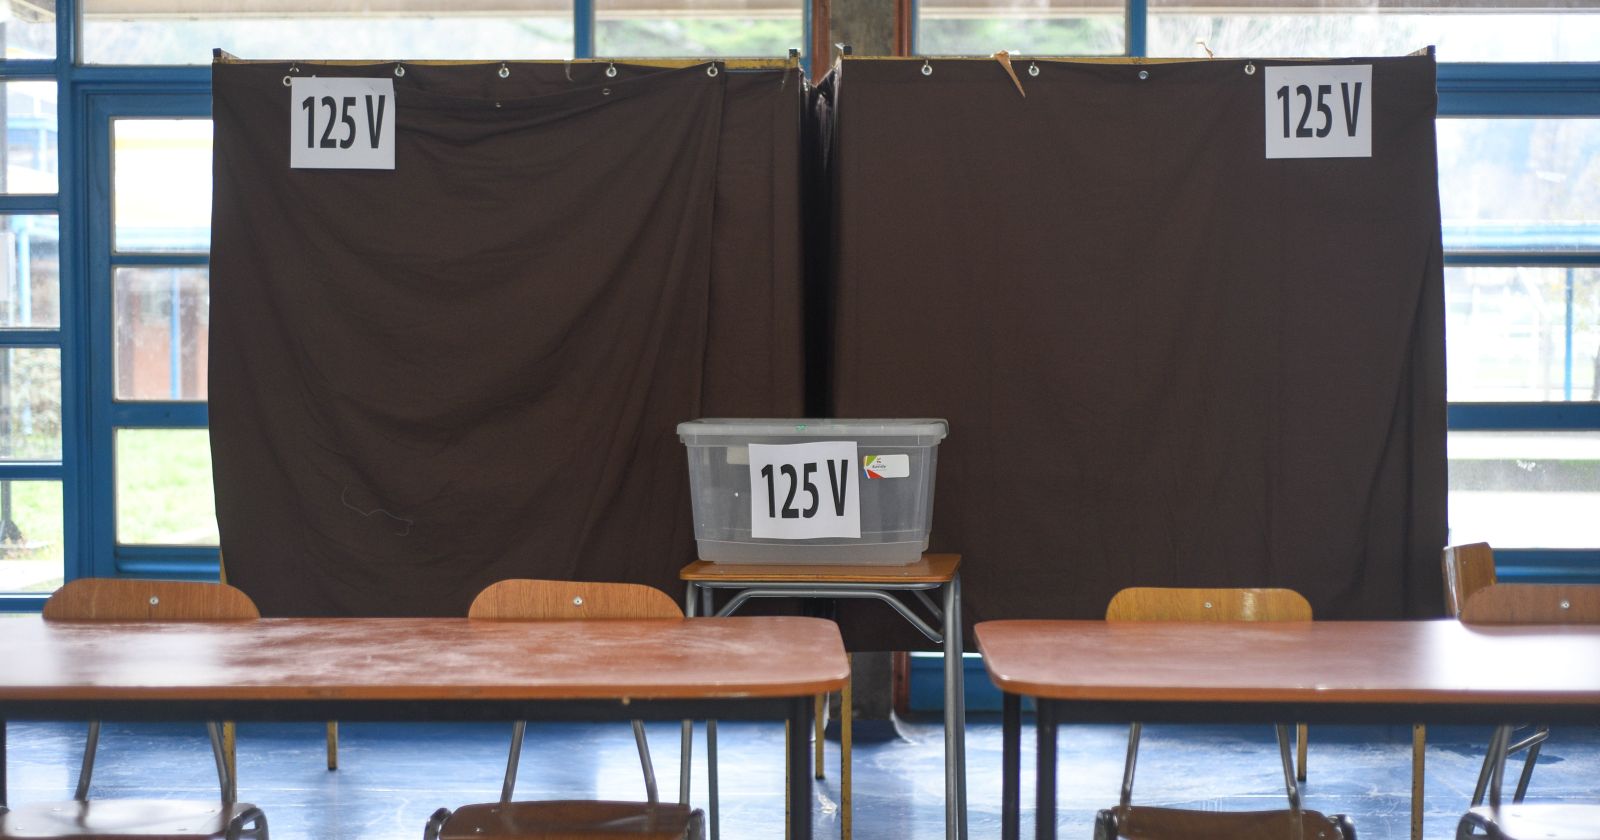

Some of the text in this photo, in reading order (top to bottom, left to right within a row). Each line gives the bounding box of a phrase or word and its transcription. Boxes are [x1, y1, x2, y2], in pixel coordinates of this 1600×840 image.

[302, 94, 386, 150] 125 V
[1276, 81, 1363, 138] 125 V
[760, 459, 849, 519] 125 V
